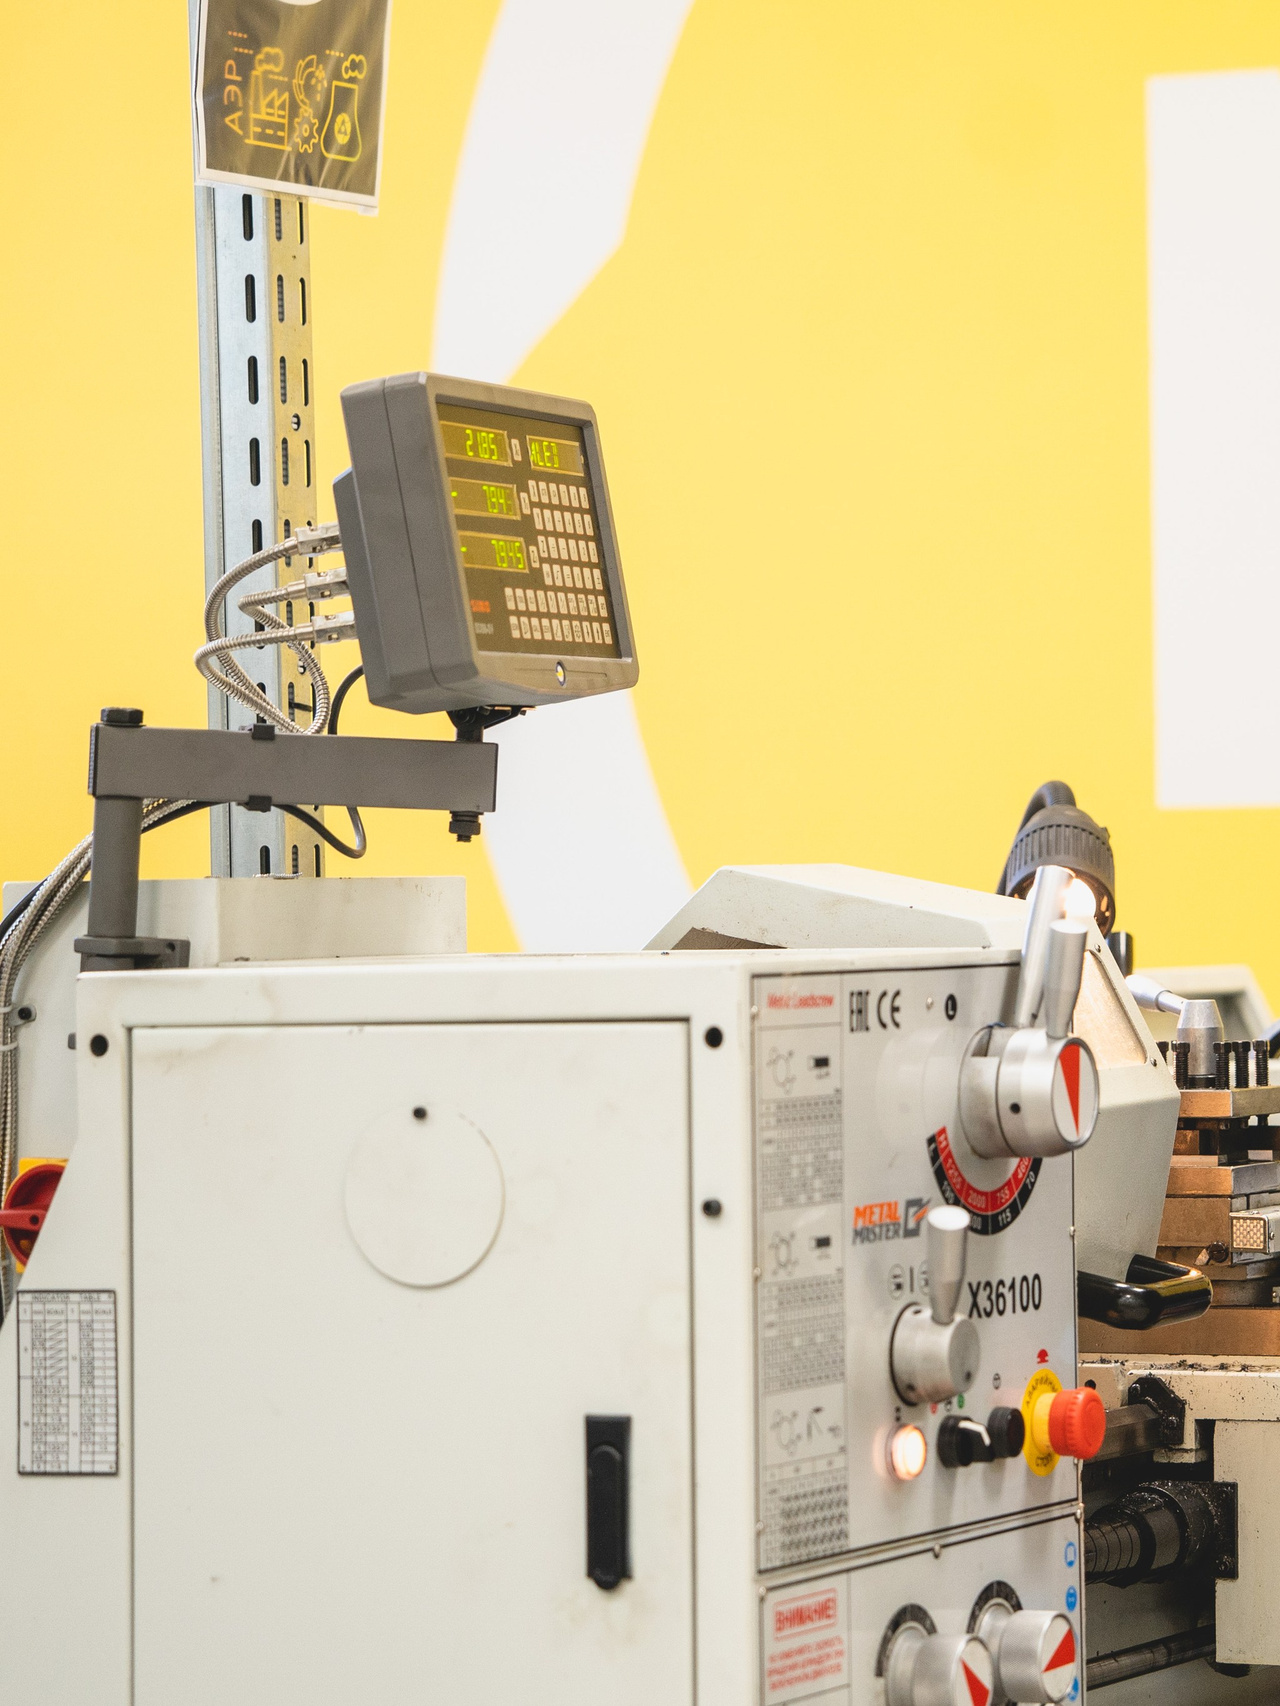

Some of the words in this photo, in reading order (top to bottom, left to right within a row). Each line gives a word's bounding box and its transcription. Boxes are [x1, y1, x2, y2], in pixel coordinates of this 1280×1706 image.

[224, 59, 244, 136] АЭР
[853, 1200, 900, 1229] METAL
[968, 1273, 1042, 1319] X36100
